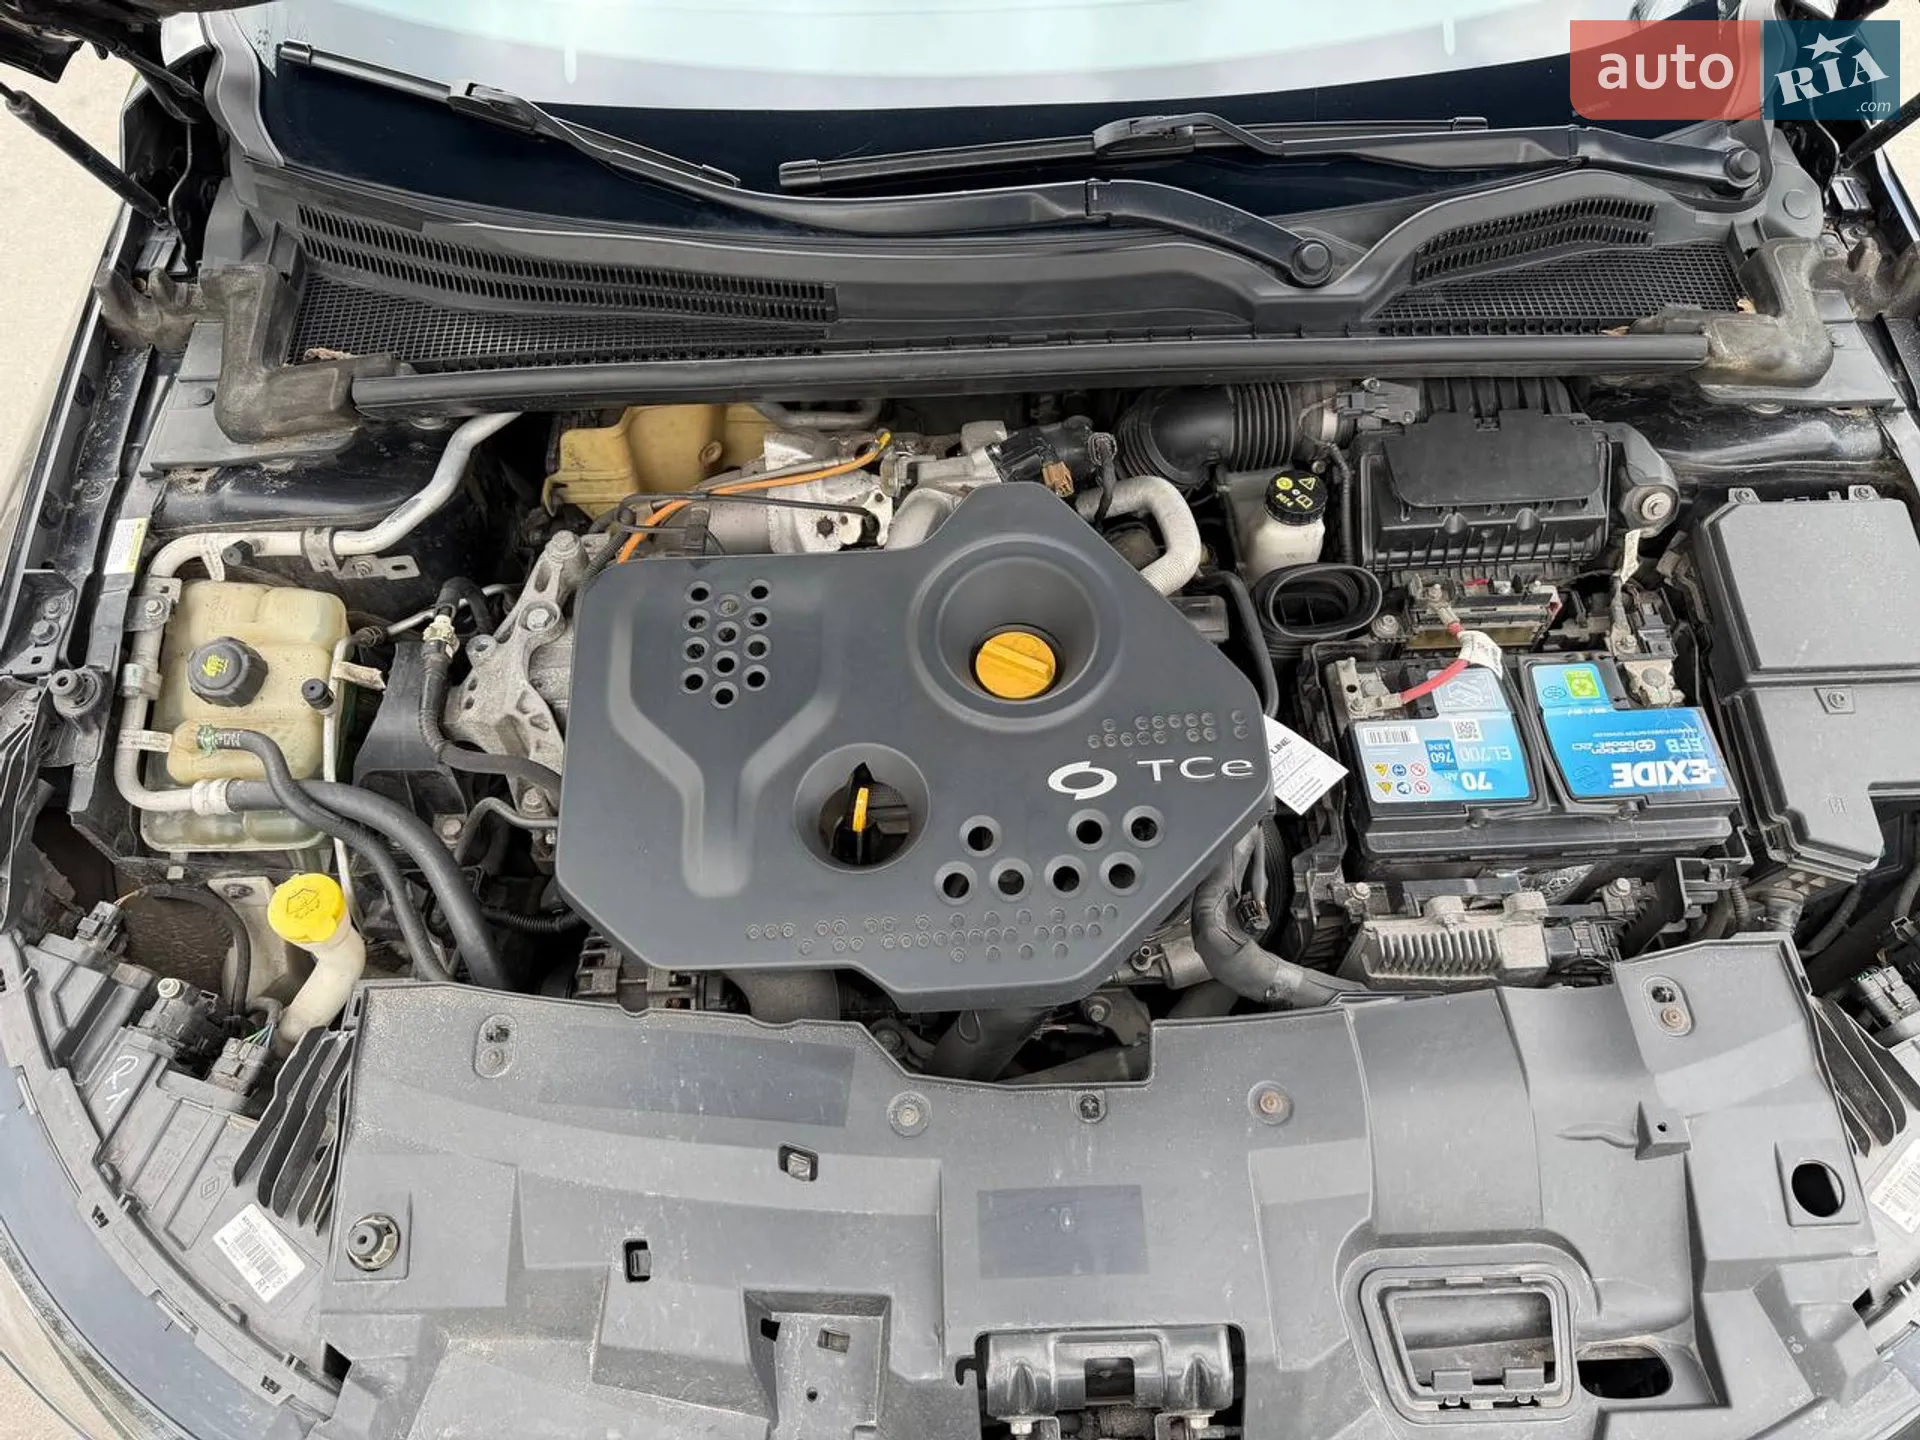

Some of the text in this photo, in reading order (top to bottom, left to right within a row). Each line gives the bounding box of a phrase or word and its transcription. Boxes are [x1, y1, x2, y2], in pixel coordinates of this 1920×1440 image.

[1460, 745, 1513, 762] EL700
[1664, 738, 1706, 753] EFB
[1429, 751, 1455, 764] 760
[1136, 756, 1255, 782] TCe
[1609, 758, 1716, 789] EXIDE
[1460, 770, 1493, 792] 70
